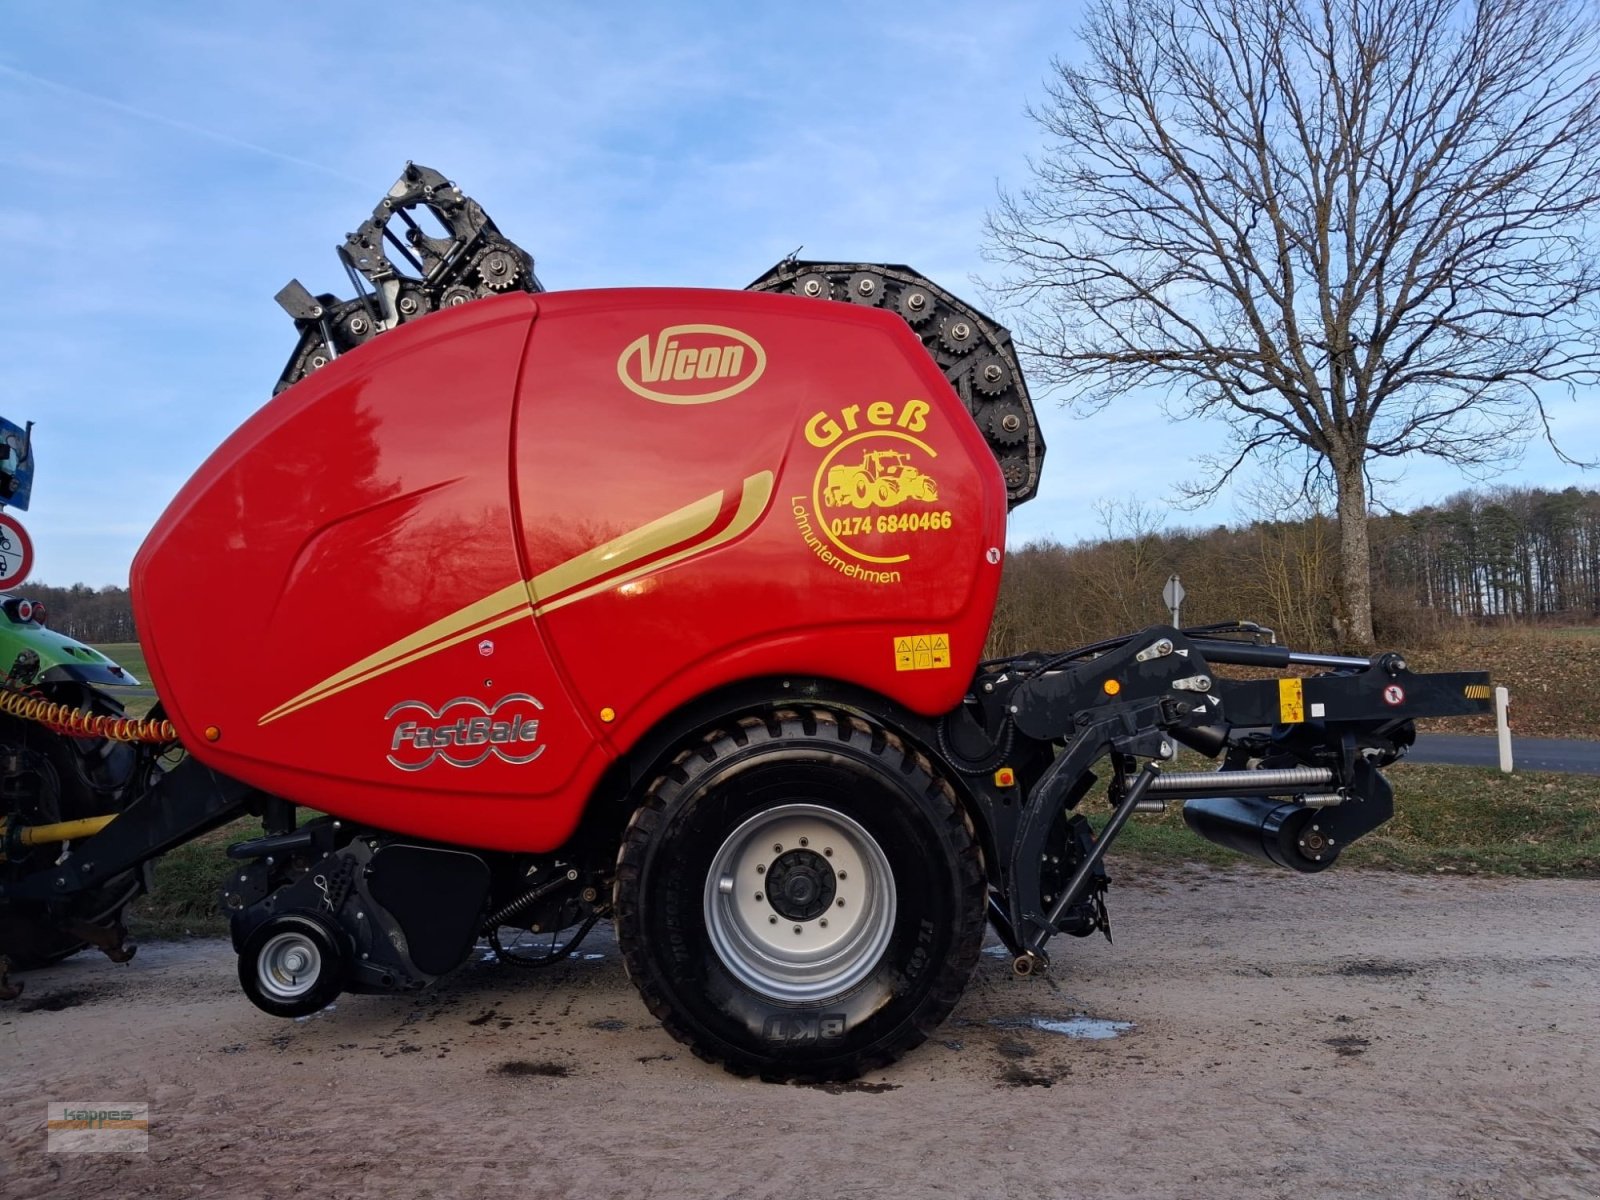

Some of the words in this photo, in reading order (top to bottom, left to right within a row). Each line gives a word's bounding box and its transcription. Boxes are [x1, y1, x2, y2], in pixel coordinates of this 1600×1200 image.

[804, 400, 930, 448] Greß
[791, 495, 901, 584] Lohnunternehmen
[832, 516, 872, 537] 0174
[876, 511, 952, 533] 6840466
[391, 714, 539, 750] FastBale
[768, 1014, 845, 1041] BKT
